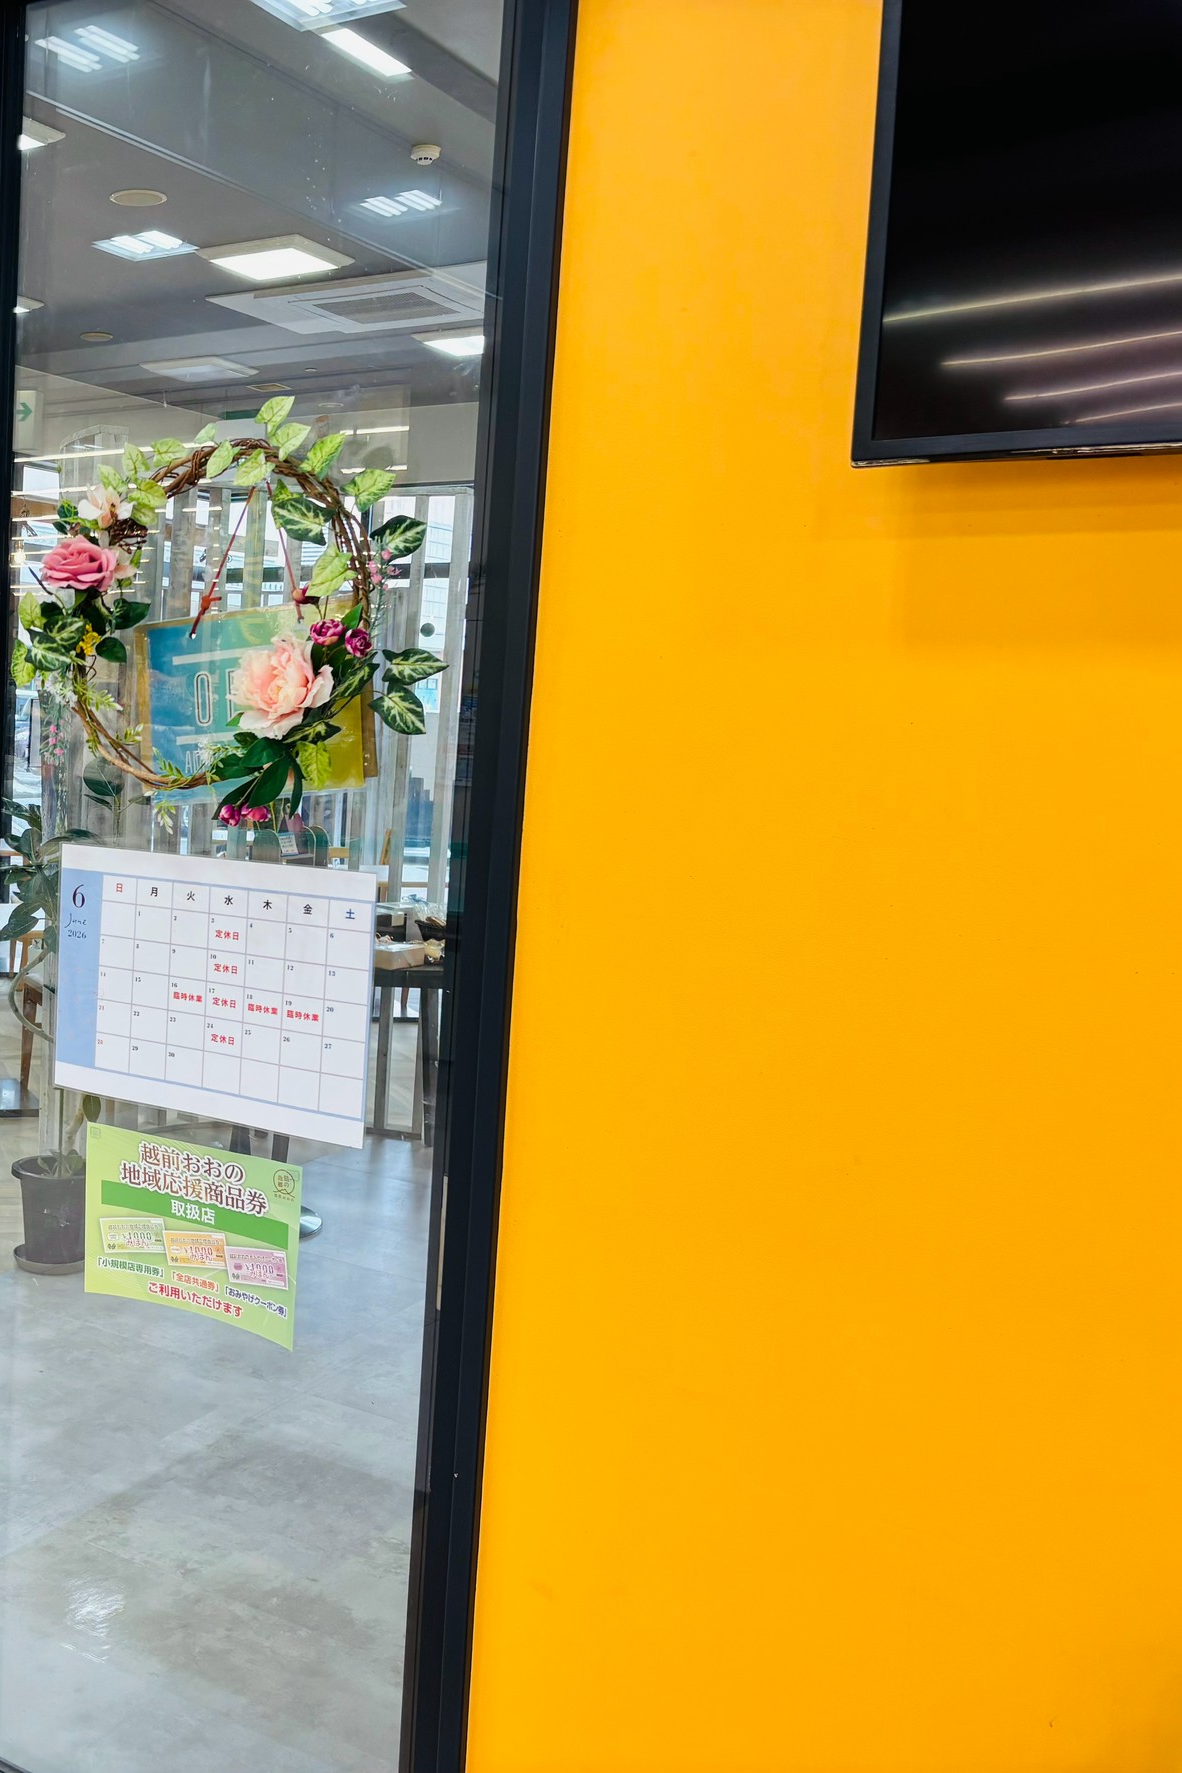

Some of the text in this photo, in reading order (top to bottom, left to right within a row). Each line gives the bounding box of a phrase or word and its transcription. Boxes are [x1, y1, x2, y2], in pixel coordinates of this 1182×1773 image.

[72, 884, 85, 909] 6
[116, 883, 355, 919] 日 月 火 水 木 金 土
[64, 913, 87, 928] June
[67, 929, 87, 940] 2026
[215, 929, 240, 941] 定休日
[213, 963, 238, 975] 定休日
[173, 991, 203, 1003] 臨時休業
[212, 997, 237, 1009] 定休日
[247, 1003, 278, 1016] 臨時休業
[286, 1009, 319, 1022] 臨時休業
[210, 1033, 235, 1046] 定休日
[140, 1143, 245, 1184] 越前おおの
[120, 1162, 267, 1215] 地域応援商品券
[171, 1200, 216, 1225] 取扱店
[148, 1282, 243, 1317] ご利用いただけます
